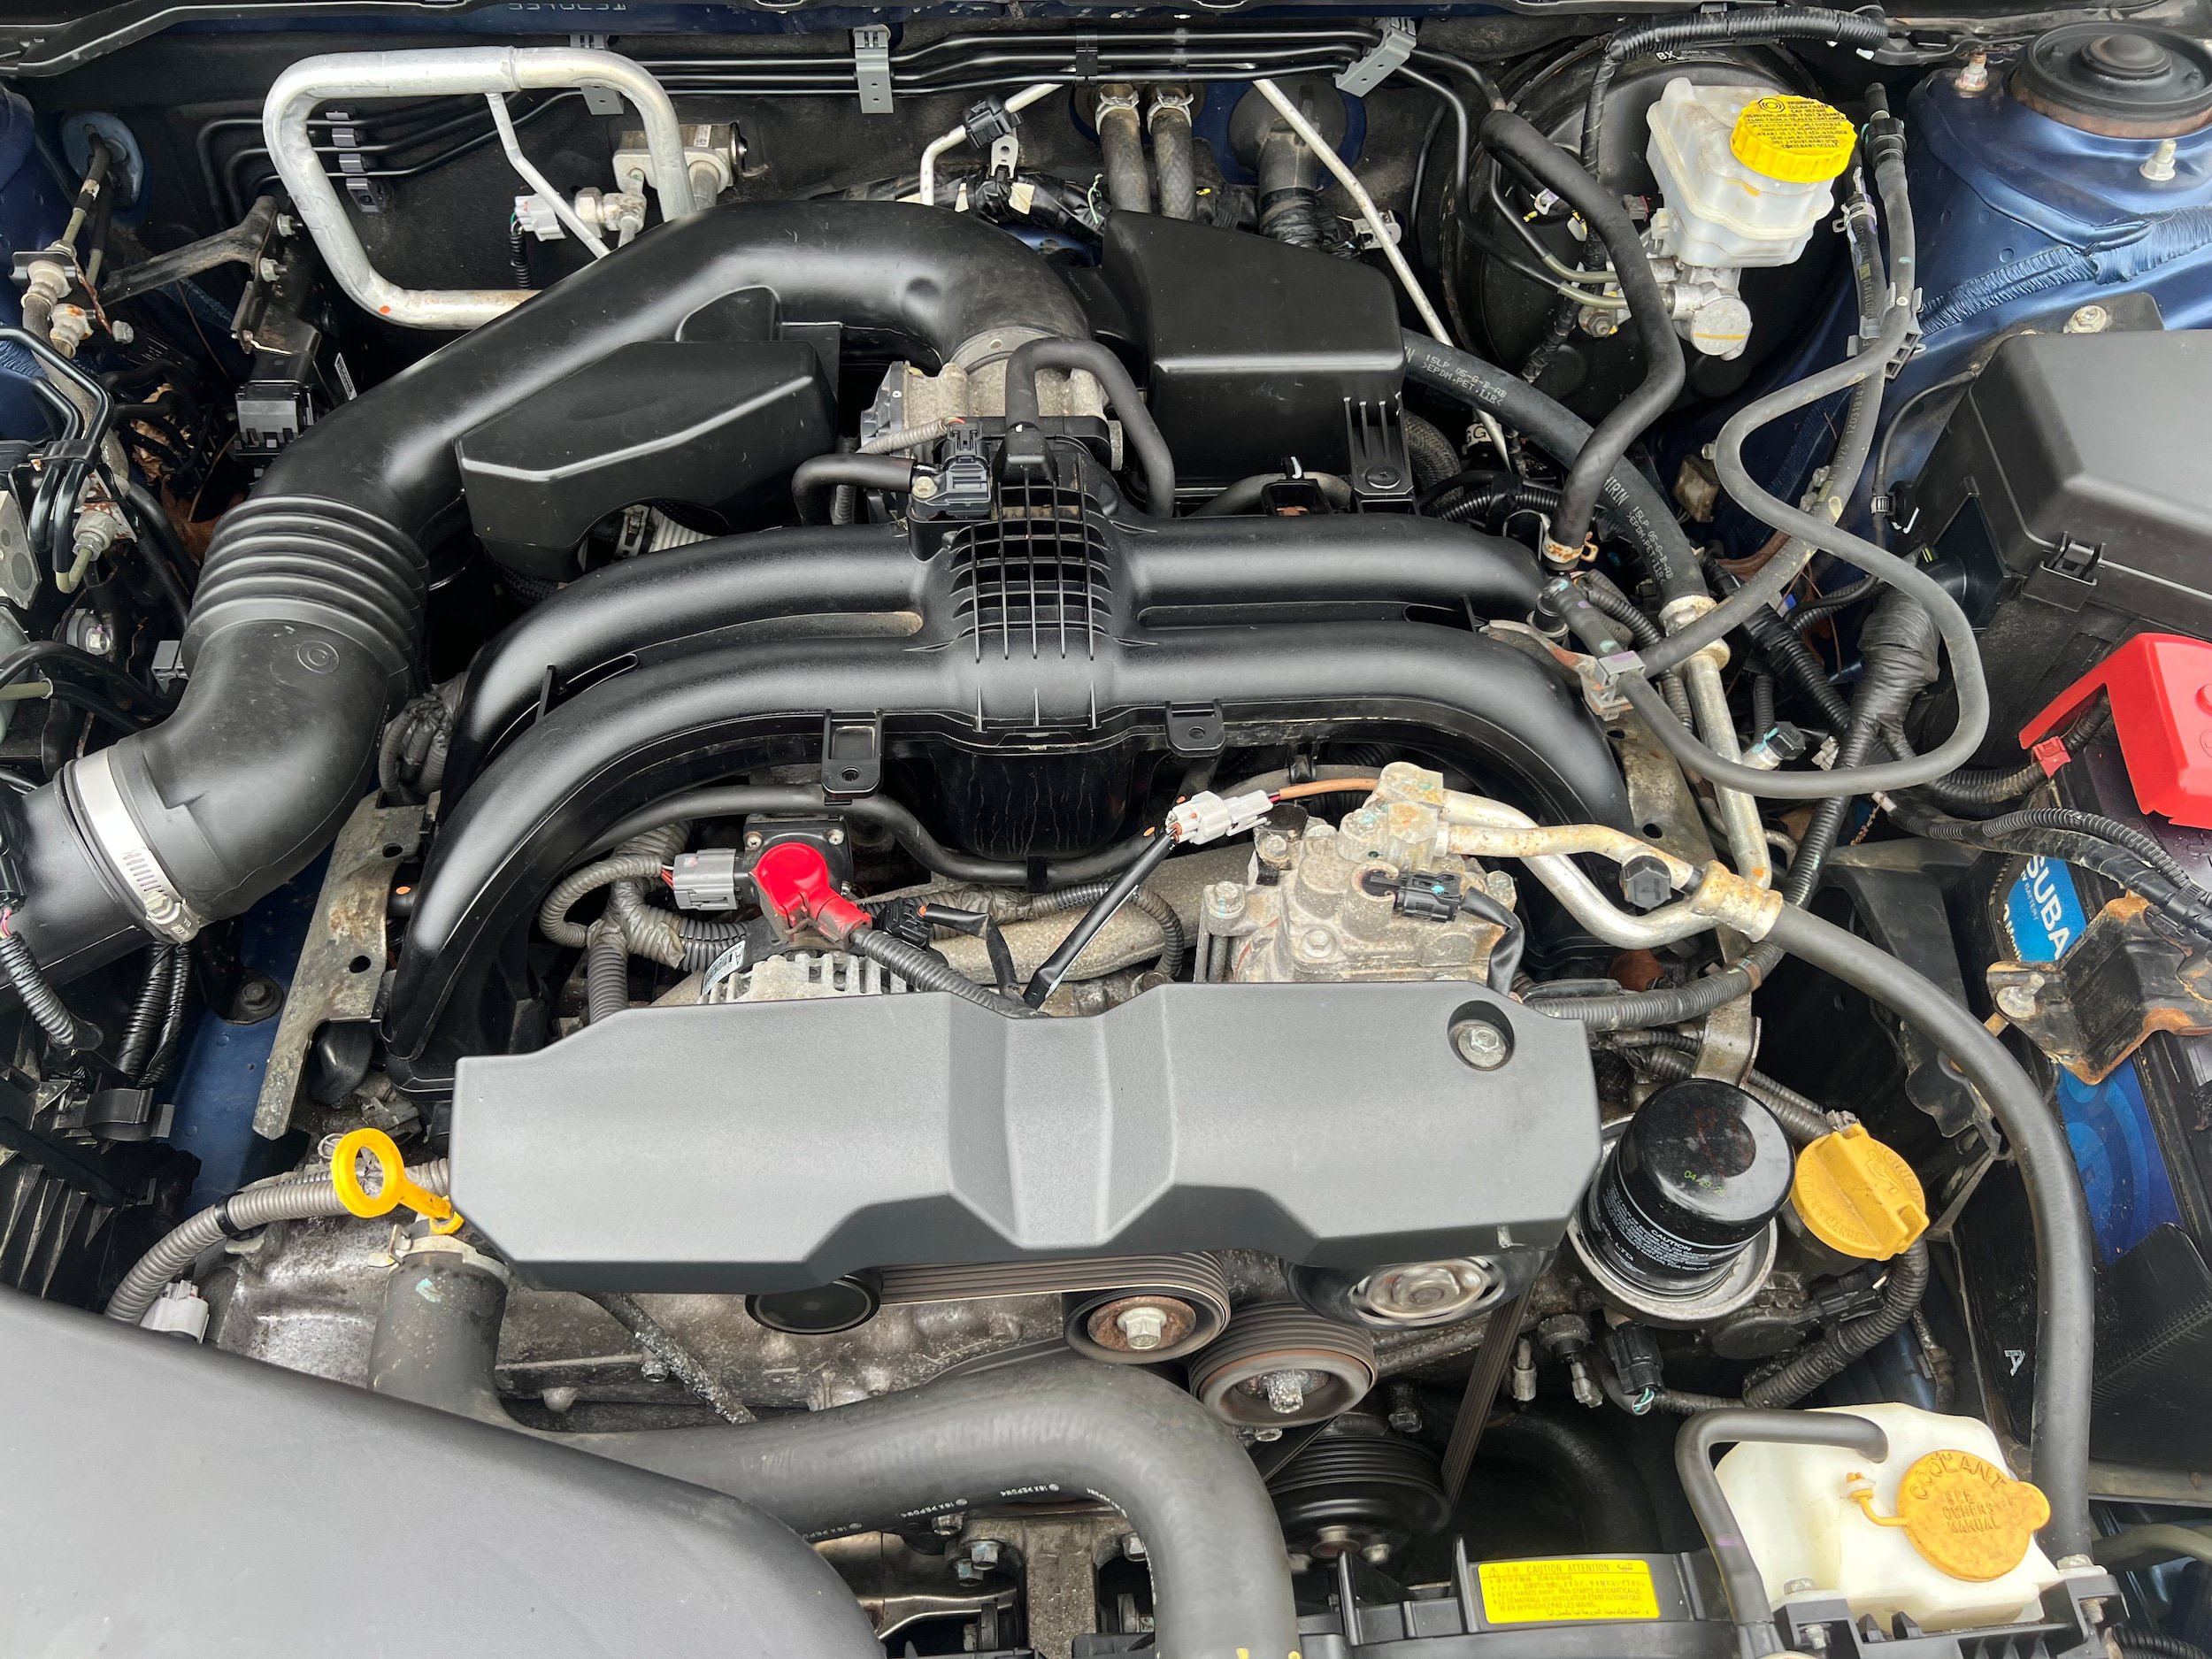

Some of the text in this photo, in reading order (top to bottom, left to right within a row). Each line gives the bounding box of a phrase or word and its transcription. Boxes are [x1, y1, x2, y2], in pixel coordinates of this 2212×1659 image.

[2025, 855, 2070, 961] SUBA
[1650, 1229, 1692, 1252] CAUTION
[1909, 1455, 2007, 1500] COOLANT
[1946, 1489, 1975, 1504] SEE
[1947, 1517, 2001, 1533] MANUAL
[1526, 1563, 1562, 1574] CAUTION
[1568, 1563, 1609, 1572] ATTENTION
